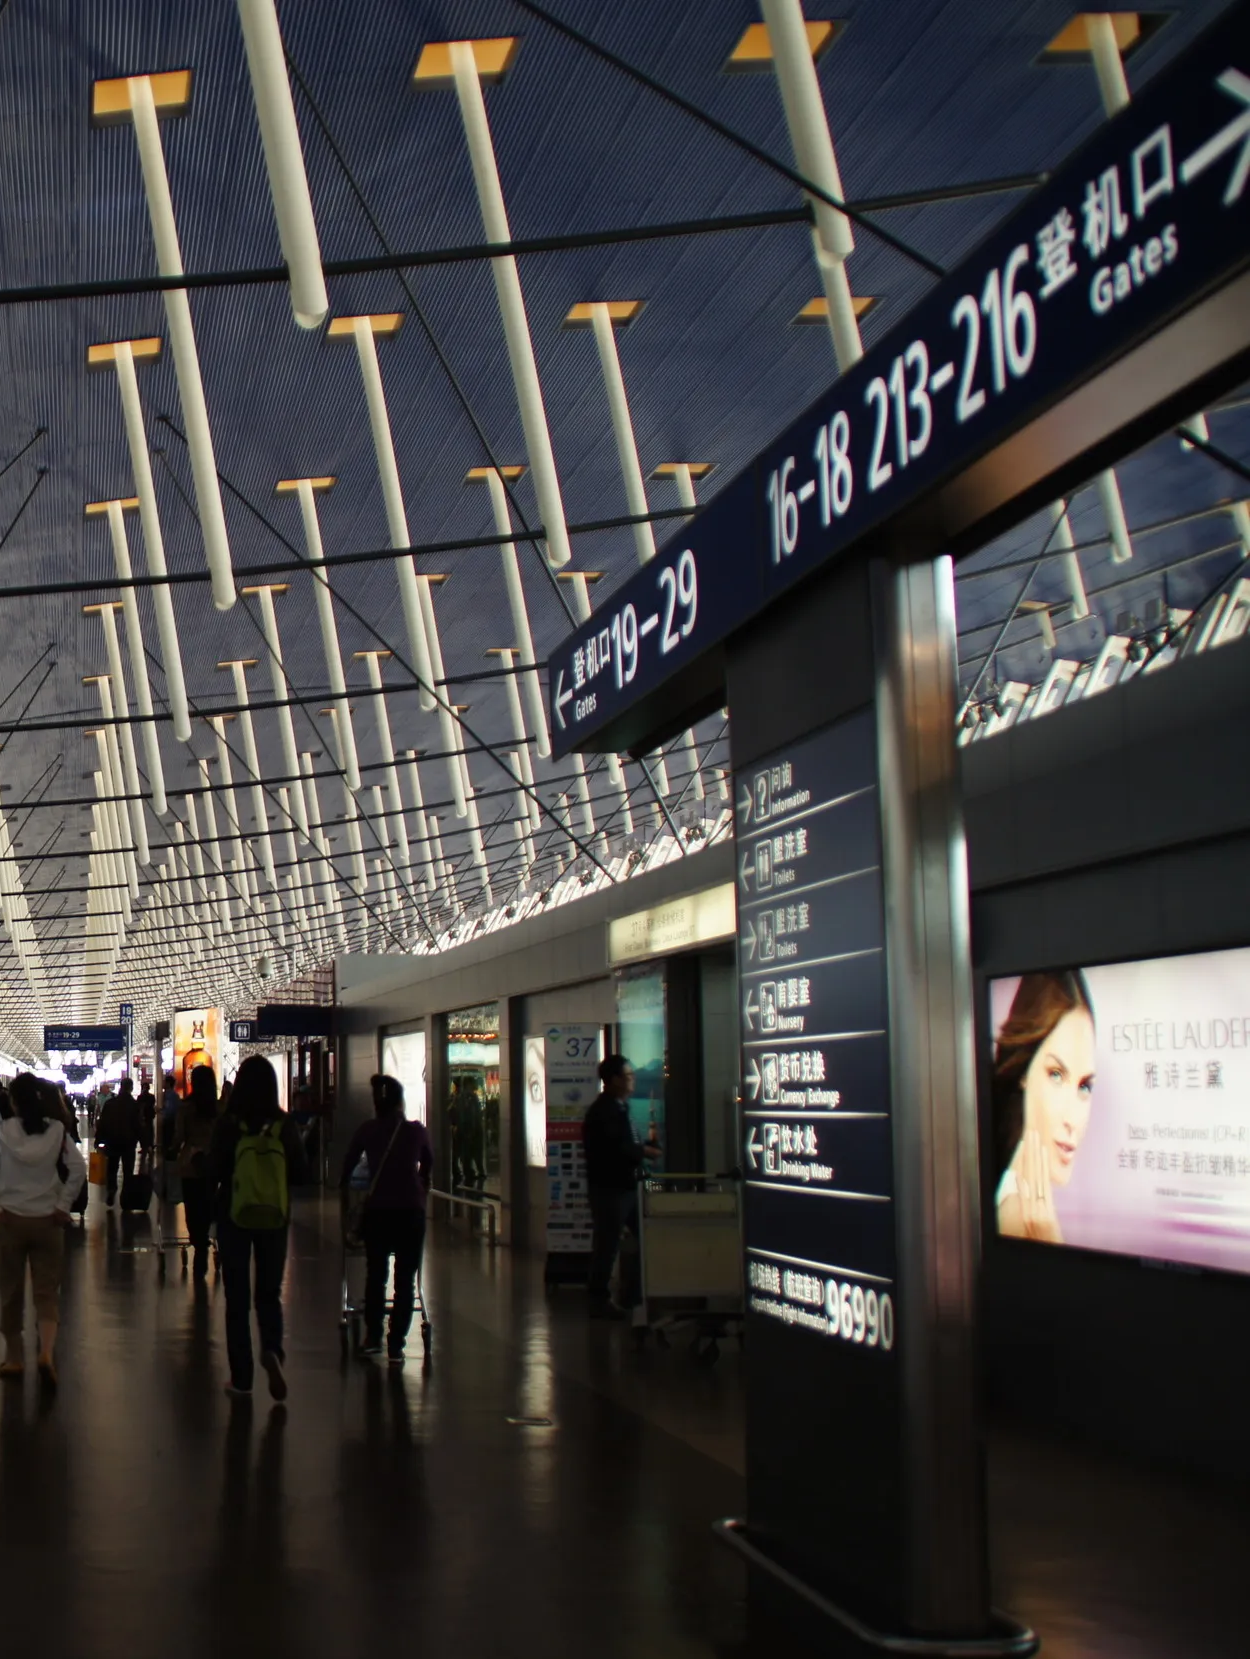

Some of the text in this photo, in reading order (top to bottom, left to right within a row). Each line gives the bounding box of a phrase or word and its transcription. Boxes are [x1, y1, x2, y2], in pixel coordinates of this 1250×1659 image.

[1090, 223, 1179, 316] Gates
[768, 123, 1174, 565] 16-18 213-216 登机口
[573, 549, 697, 690] 登机口 19-29
[575, 693, 597, 721] Gates
[771, 761, 792, 793] 问询
[771, 789, 811, 815] Information
[774, 869, 795, 886] Toilets
[776, 941, 798, 957] Toilets
[778, 976, 811, 1008] 育婴室
[121, 1016, 131, 1024] 20
[122, 1006, 132, 1015] 19
[778, 1015, 804, 1032] Nursery
[566, 1037, 597, 1058] 37
[779, 1051, 825, 1082] 货币兑换
[1144, 1060, 1225, 1090] 雅诗兰黛
[780, 1088, 840, 1109] Currency Exchange
[782, 1124, 818, 1156] 饮水处
[782, 1161, 833, 1181] Drinking Water
[824, 1278, 893, 1351] 96990
